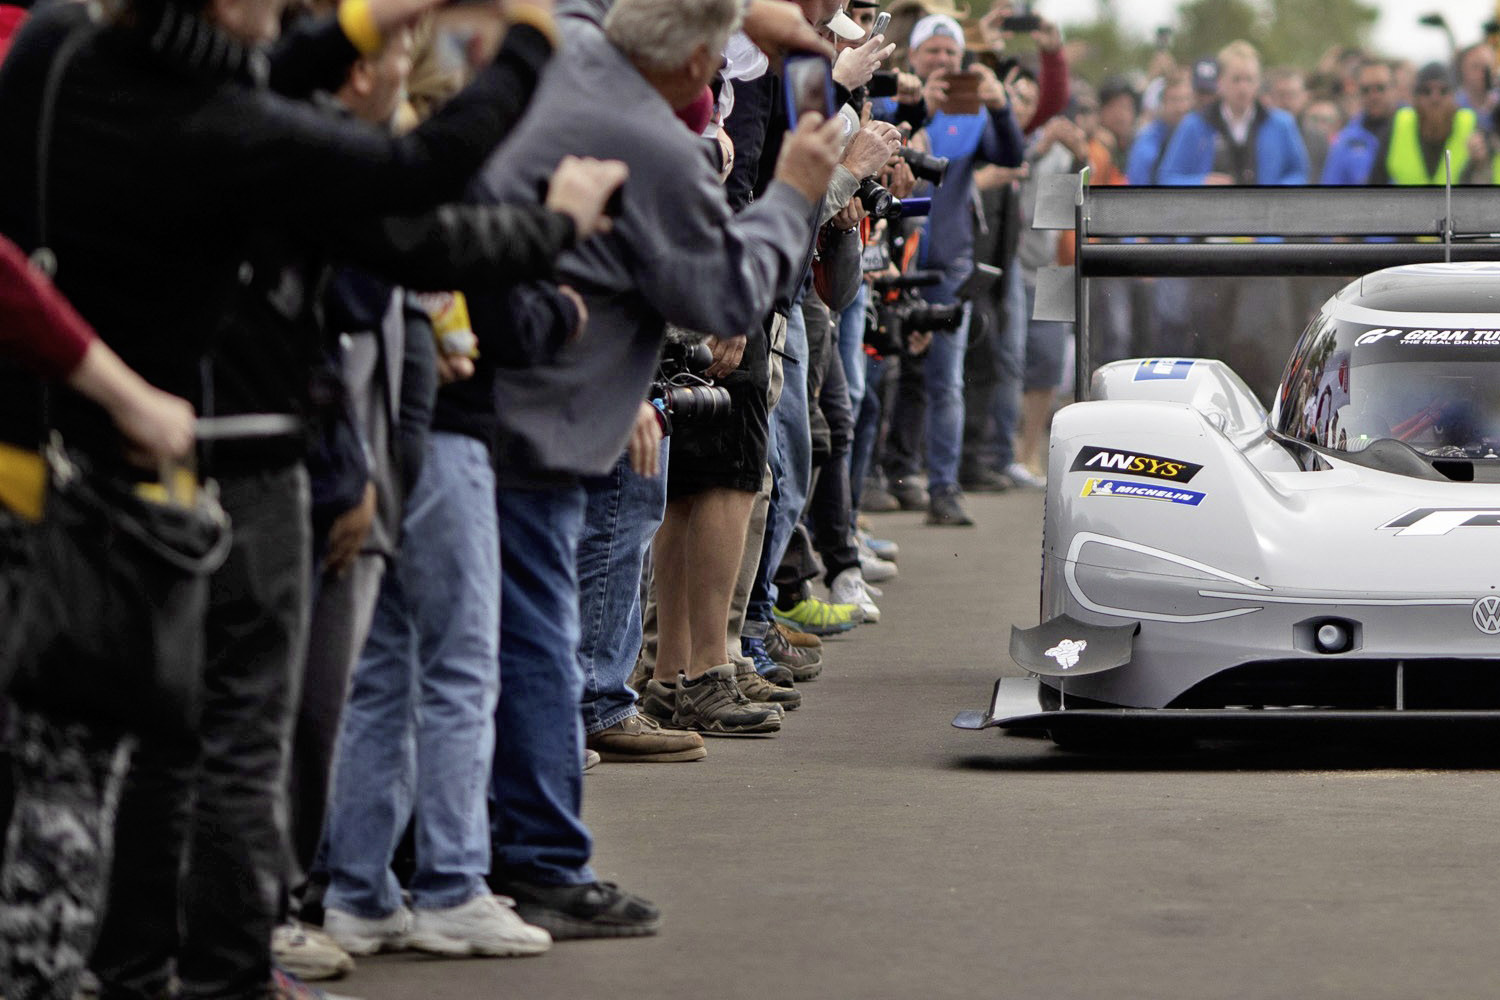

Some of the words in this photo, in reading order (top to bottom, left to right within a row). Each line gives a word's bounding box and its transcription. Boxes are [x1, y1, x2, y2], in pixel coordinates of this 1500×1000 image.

[1404, 329, 1469, 341] GRAN
[1085, 451, 1184, 477] ANSYS
[1115, 485, 1194, 502] MICHELIN
